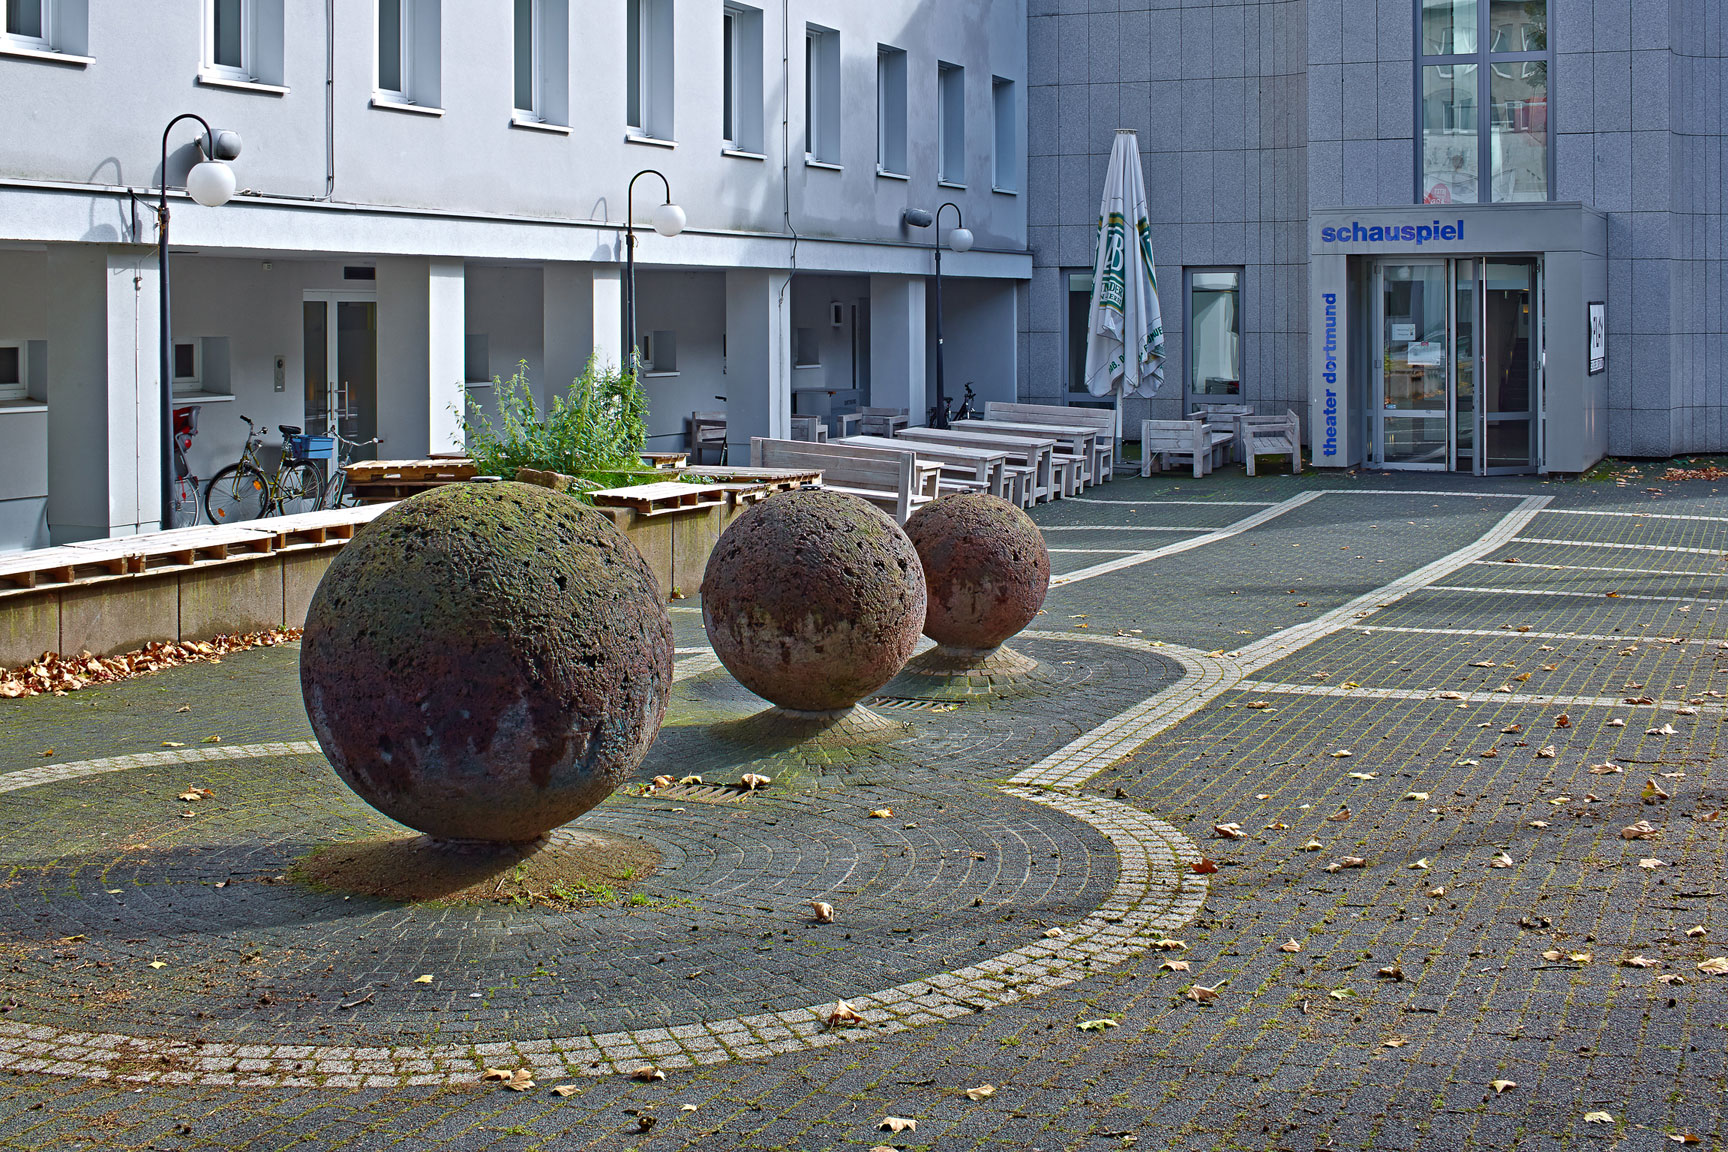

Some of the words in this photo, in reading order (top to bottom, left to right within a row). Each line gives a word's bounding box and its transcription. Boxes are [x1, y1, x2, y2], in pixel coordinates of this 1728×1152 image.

[1322, 219, 1464, 245] schauspiel
[1322, 293, 1337, 384] dortmund
[1323, 389, 1337, 457] theater
